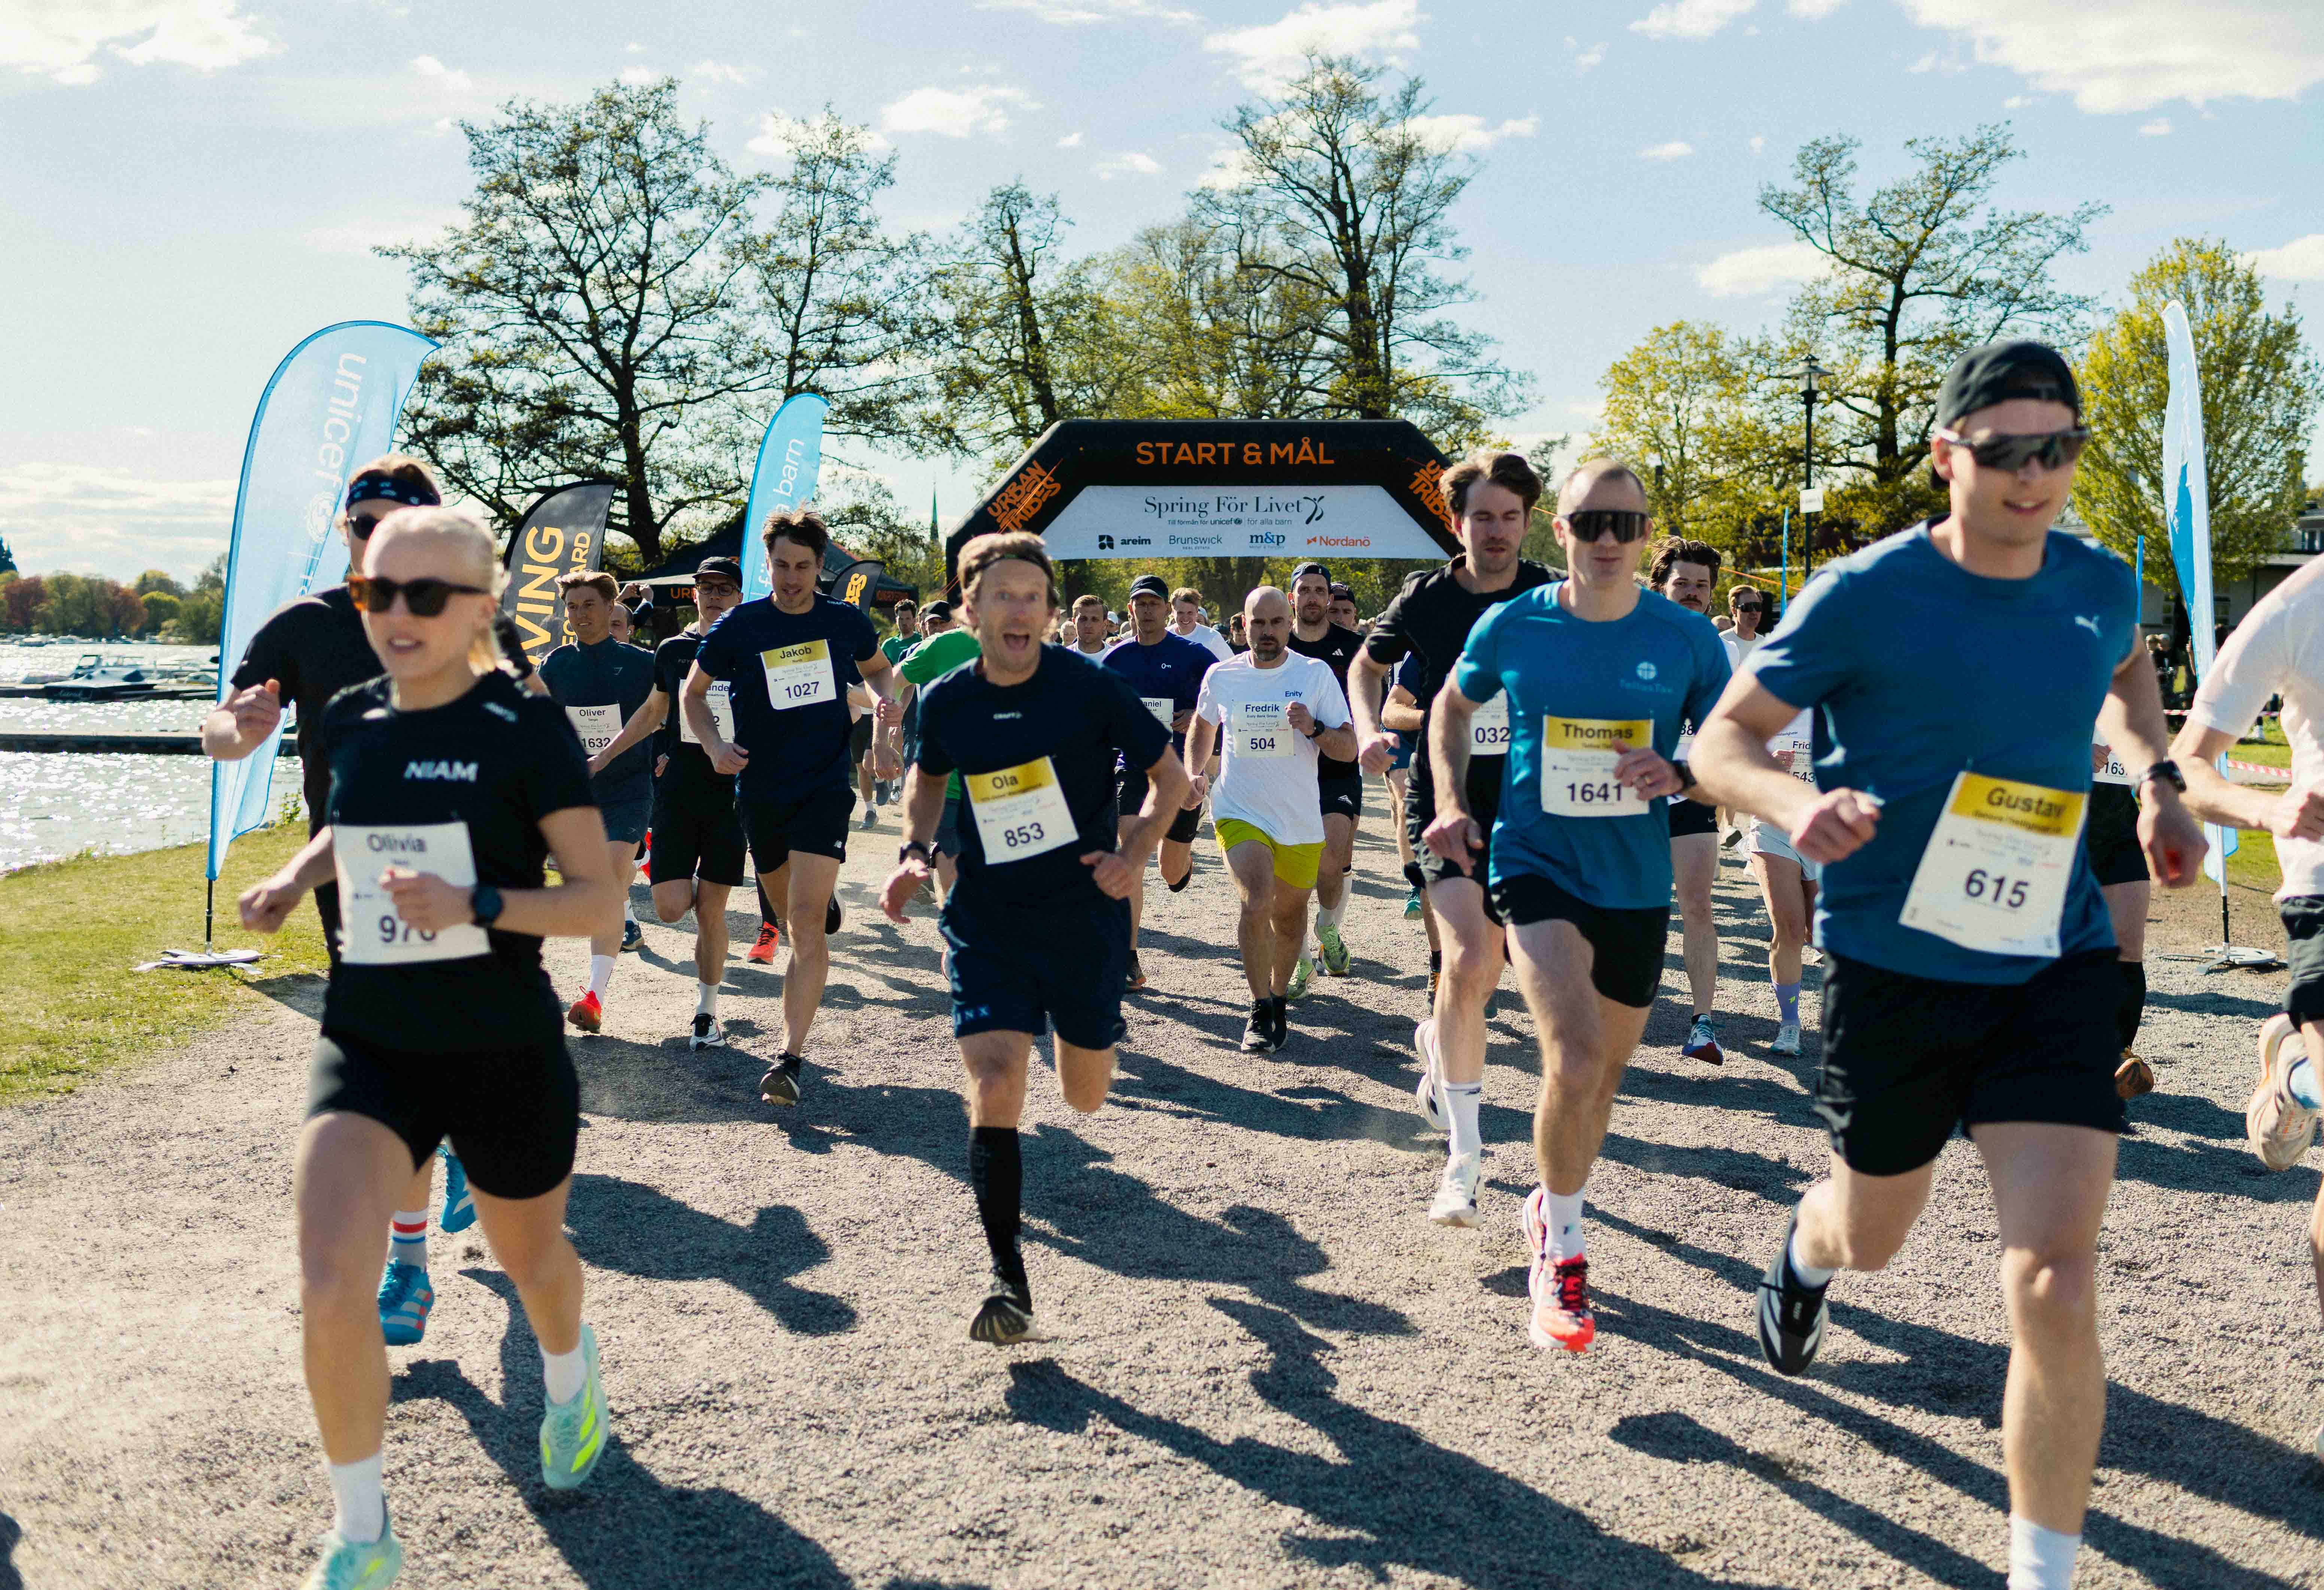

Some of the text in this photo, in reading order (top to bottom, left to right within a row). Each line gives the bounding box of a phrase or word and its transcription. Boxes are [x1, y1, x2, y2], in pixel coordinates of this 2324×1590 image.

[1136, 437, 1335, 465] START & MÅL
[773, 438, 805, 497] barn
[987, 460, 1047, 517] URBAN
[1144, 496, 1303, 518] Spring För Livet
[1120, 536, 1152, 545] areim
[1169, 534, 1223, 544] Brunswick
[1249, 531, 1286, 546] m&p
[1319, 536, 1371, 547] Nordanö
[515, 526, 564, 666] VING
[779, 646, 812, 659] Jakob
[785, 681, 820, 699] 1027
[1245, 704, 1280, 712] Fredrik
[1561, 723, 1633, 739] Thomas
[582, 737, 611, 748] 1632
[1250, 737, 1275, 750] 504
[403, 760, 480, 783] NIAM
[1788, 771, 1816, 783] 543
[2104, 762, 2128, 776] 163
[992, 775, 1018, 789] Ola
[1566, 782, 1623, 802] 1641
[1986, 787, 2066, 819] Gustav
[367, 832, 427, 853] Olivia
[1004, 822, 1044, 847] 853
[1965, 869, 2030, 908] 615
